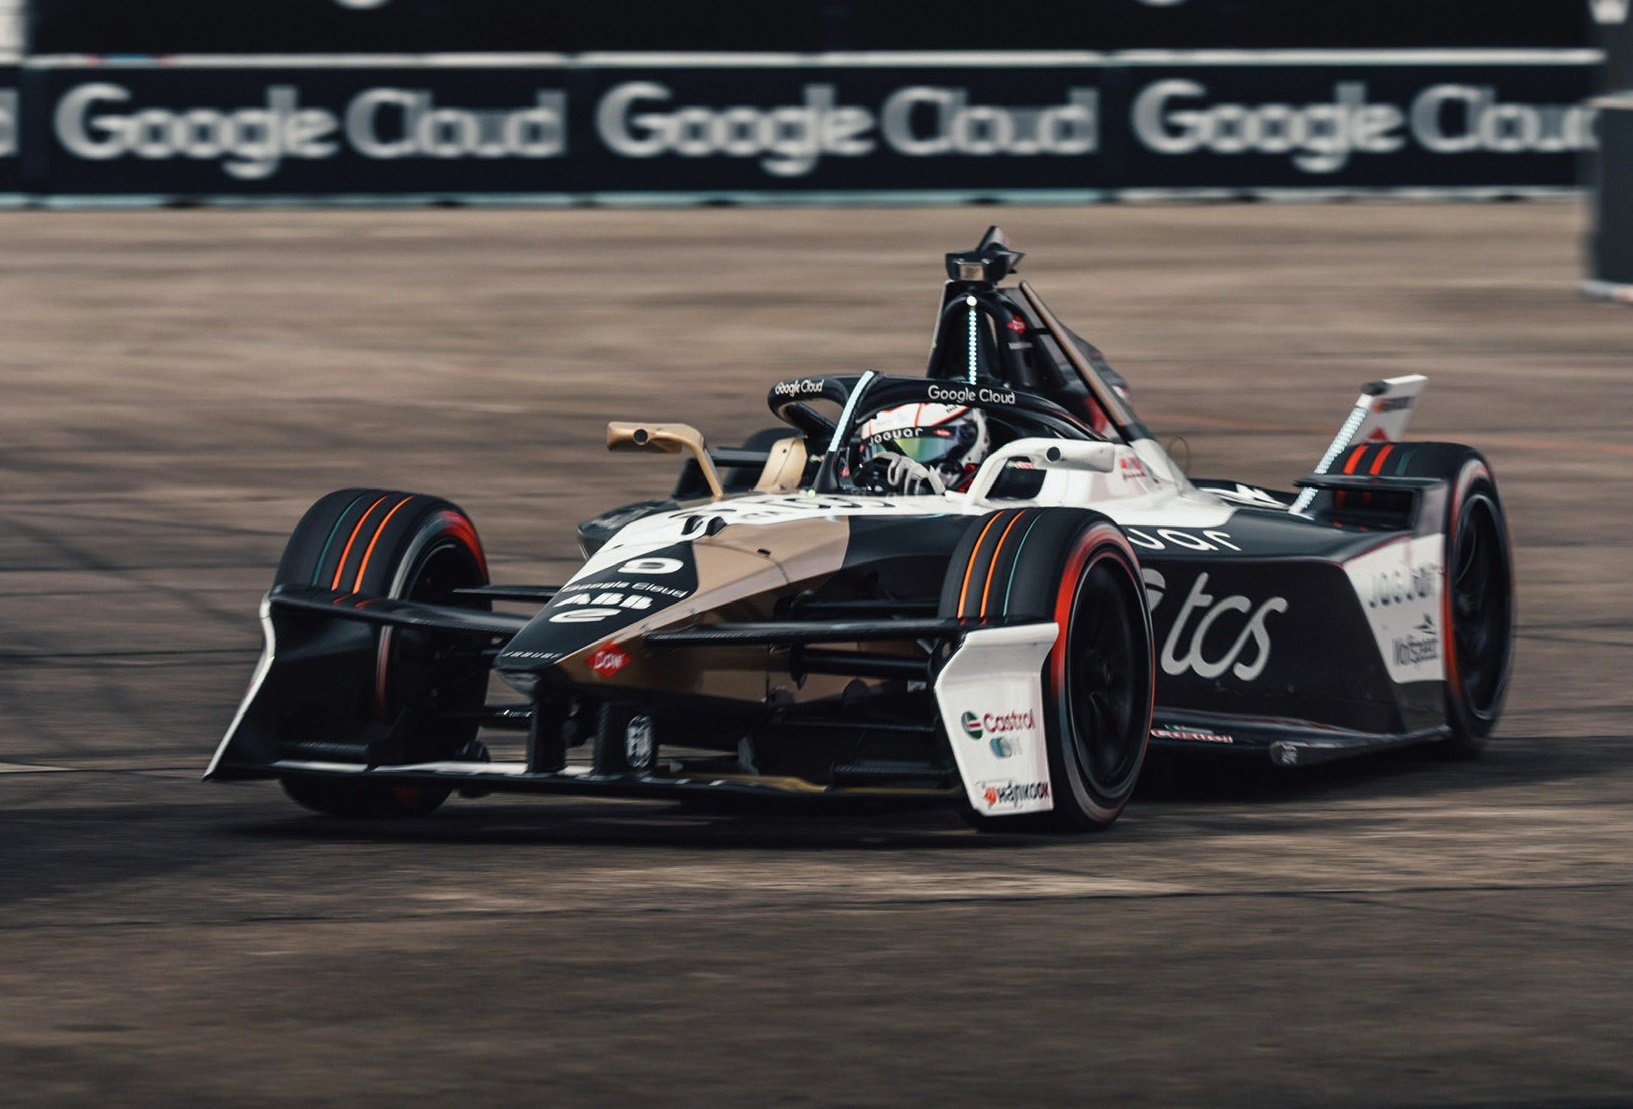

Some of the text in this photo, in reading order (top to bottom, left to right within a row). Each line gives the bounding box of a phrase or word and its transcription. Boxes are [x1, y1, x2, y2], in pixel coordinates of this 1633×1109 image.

[54, 83, 339, 179] Google
[345, 87, 567, 158] Cloud
[596, 82, 1100, 176] Google Cloud
[1131, 80, 1403, 174] Google
[927, 384, 1016, 405] Google Cloud
[552, 592, 654, 610] ABB
[1160, 571, 1289, 681] tcs
[983, 708, 1036, 733] Castrol
